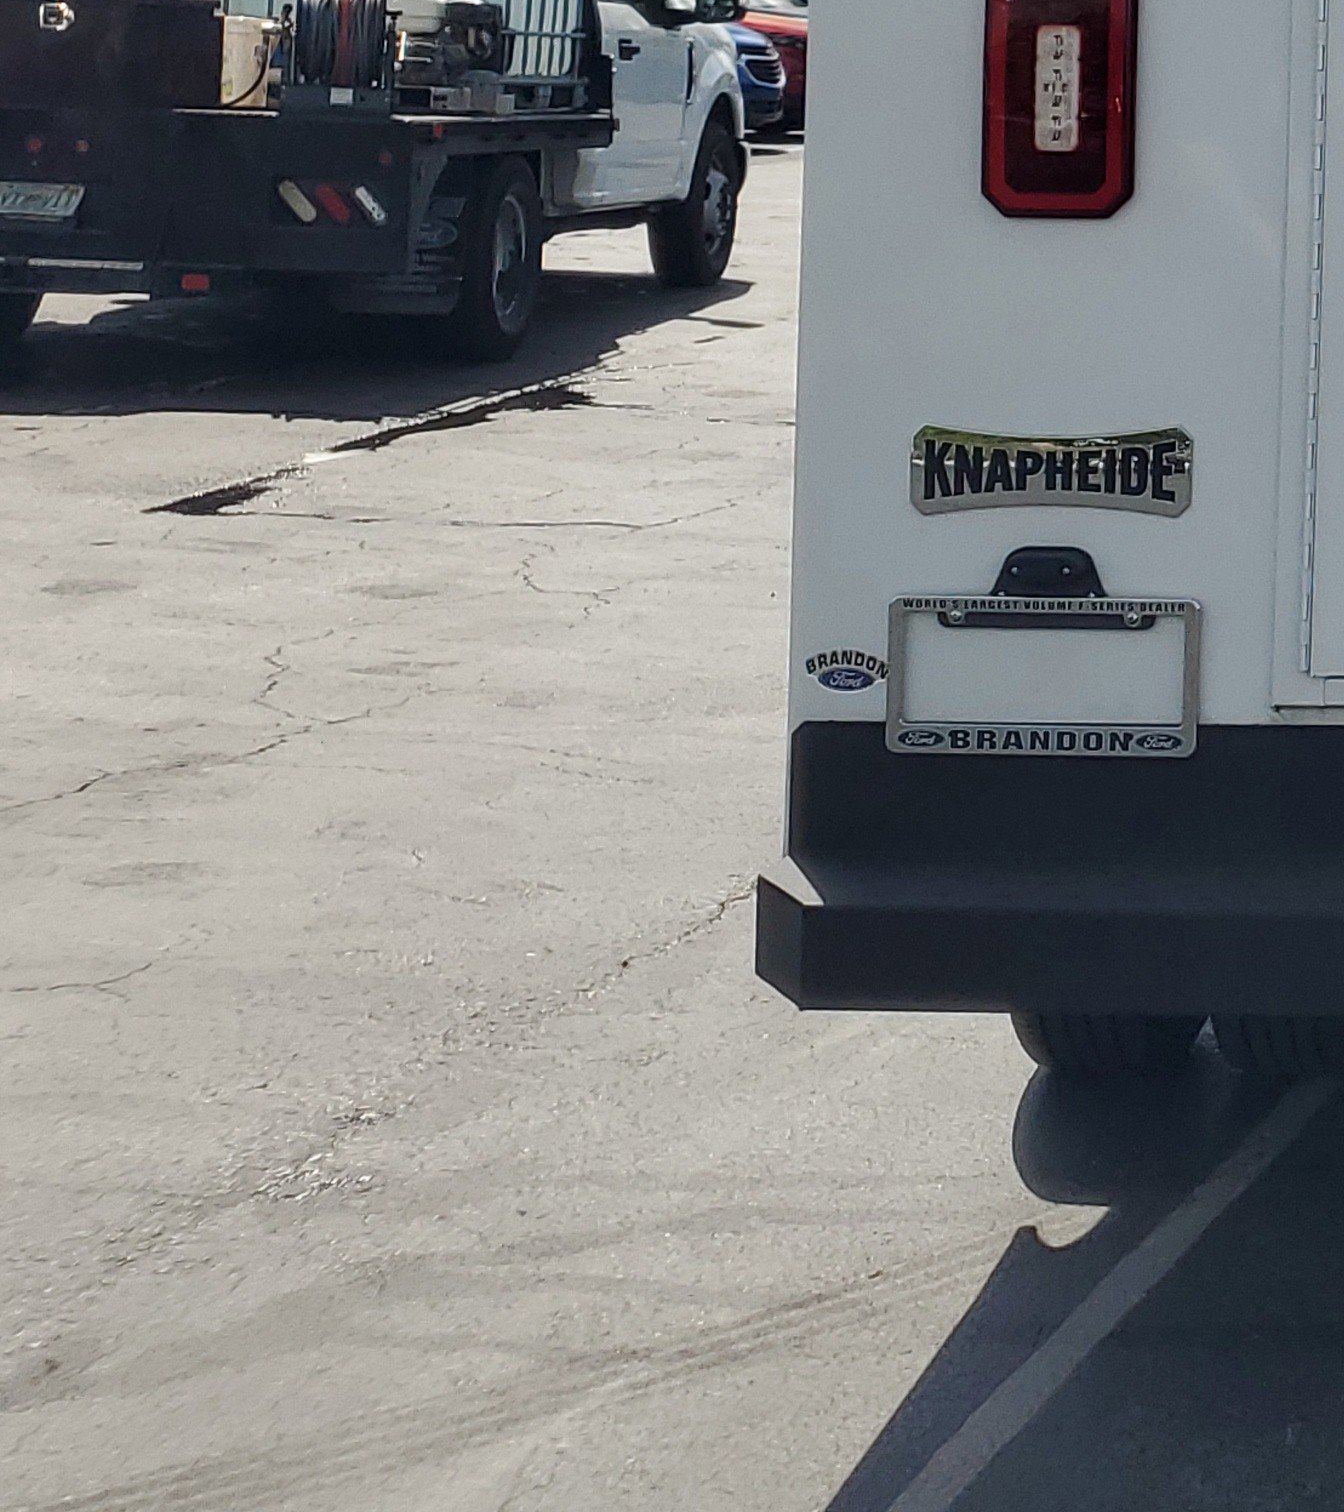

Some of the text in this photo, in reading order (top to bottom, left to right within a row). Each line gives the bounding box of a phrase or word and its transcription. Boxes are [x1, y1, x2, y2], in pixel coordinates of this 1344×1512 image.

[923, 438, 1177, 503] KNAPHEIDE
[805, 649, 889, 679] BRANDON
[829, 671, 864, 687] Ford
[905, 729, 1174, 751] Ford BRANDON Ford
